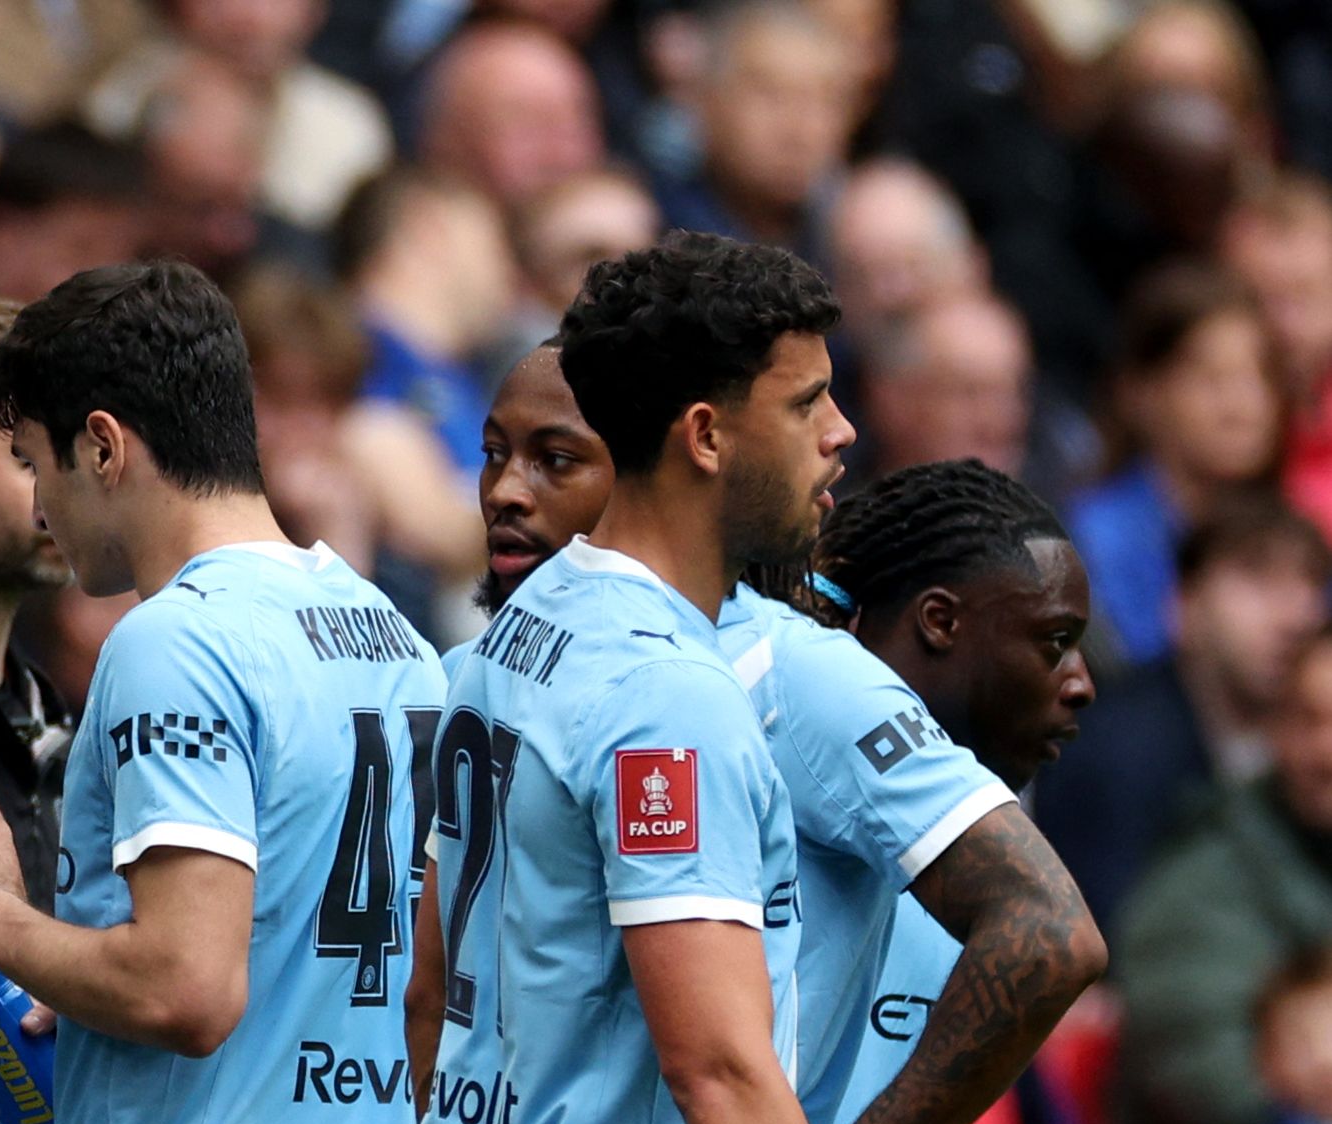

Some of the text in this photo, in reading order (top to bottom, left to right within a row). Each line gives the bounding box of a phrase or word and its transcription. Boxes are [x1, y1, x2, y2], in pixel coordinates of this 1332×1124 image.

[295, 606, 424, 662] KHUSANO
[471, 603, 556, 677] ATHEUS
[108, 712, 227, 770] OKX
[629, 820, 687, 836] FA CUP
